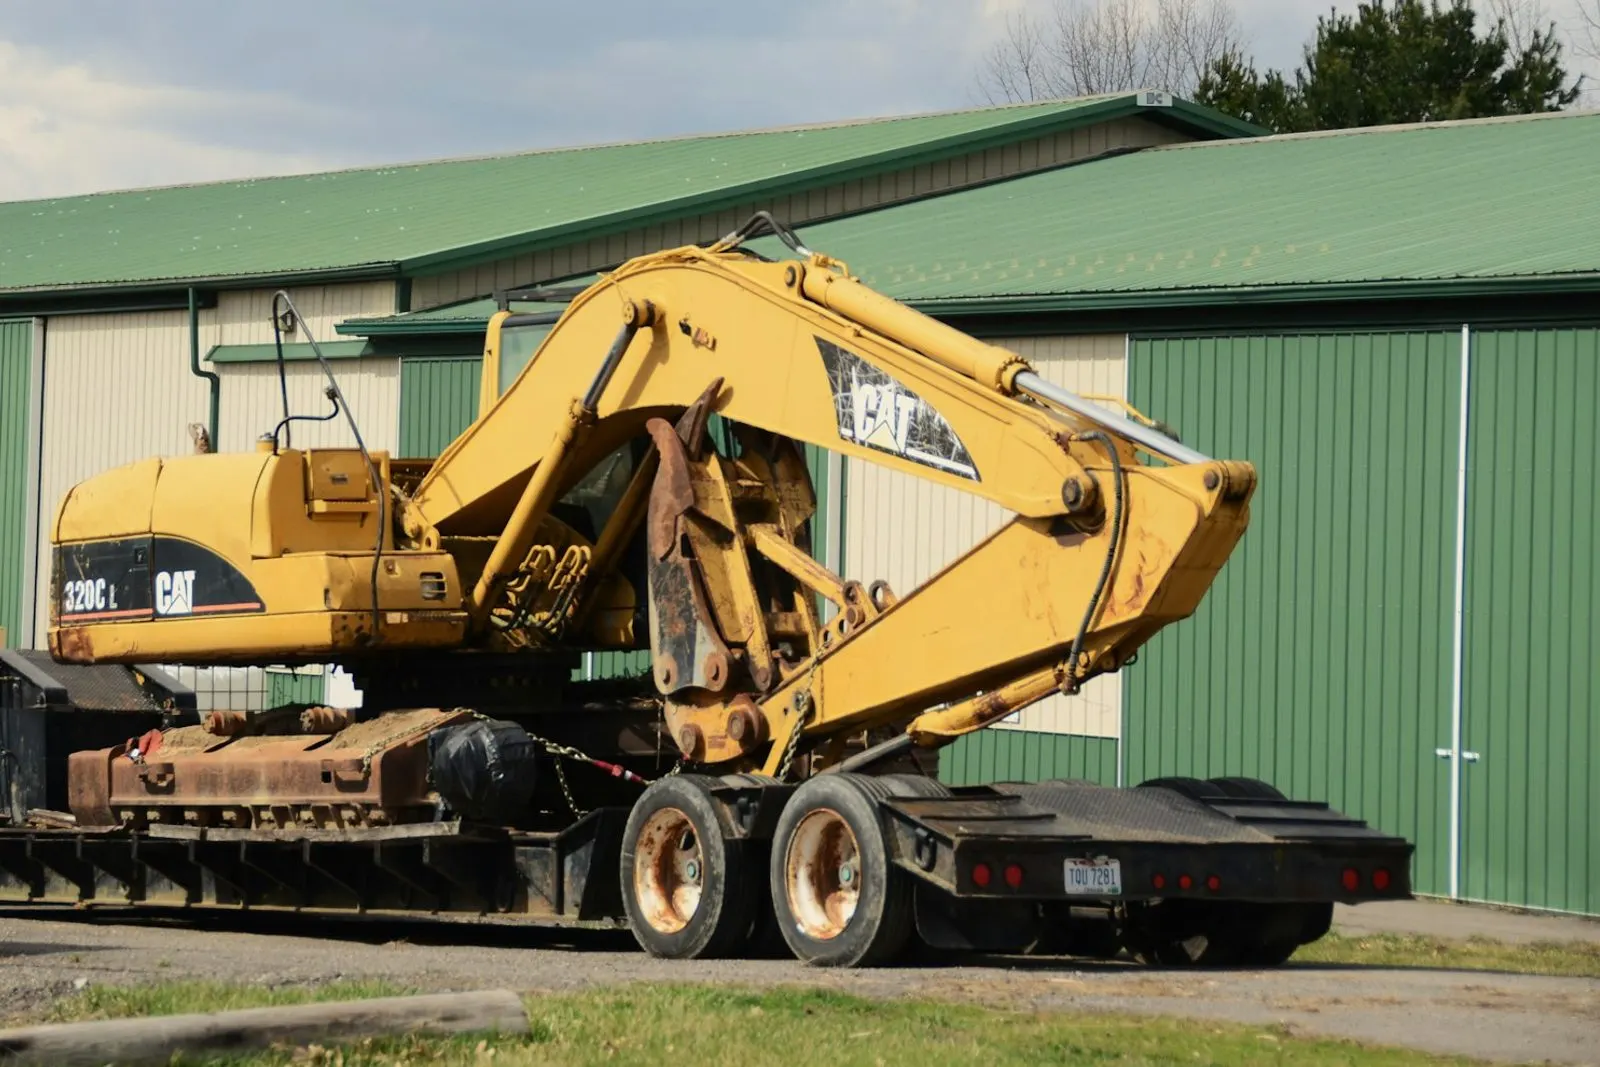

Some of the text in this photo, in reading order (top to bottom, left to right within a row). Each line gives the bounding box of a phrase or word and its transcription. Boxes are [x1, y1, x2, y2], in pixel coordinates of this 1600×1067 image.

[853, 382, 915, 453] CAT
[64, 578, 118, 612] 320C L
[155, 570, 196, 614] CAT
[1091, 868, 1116, 885] 7281
